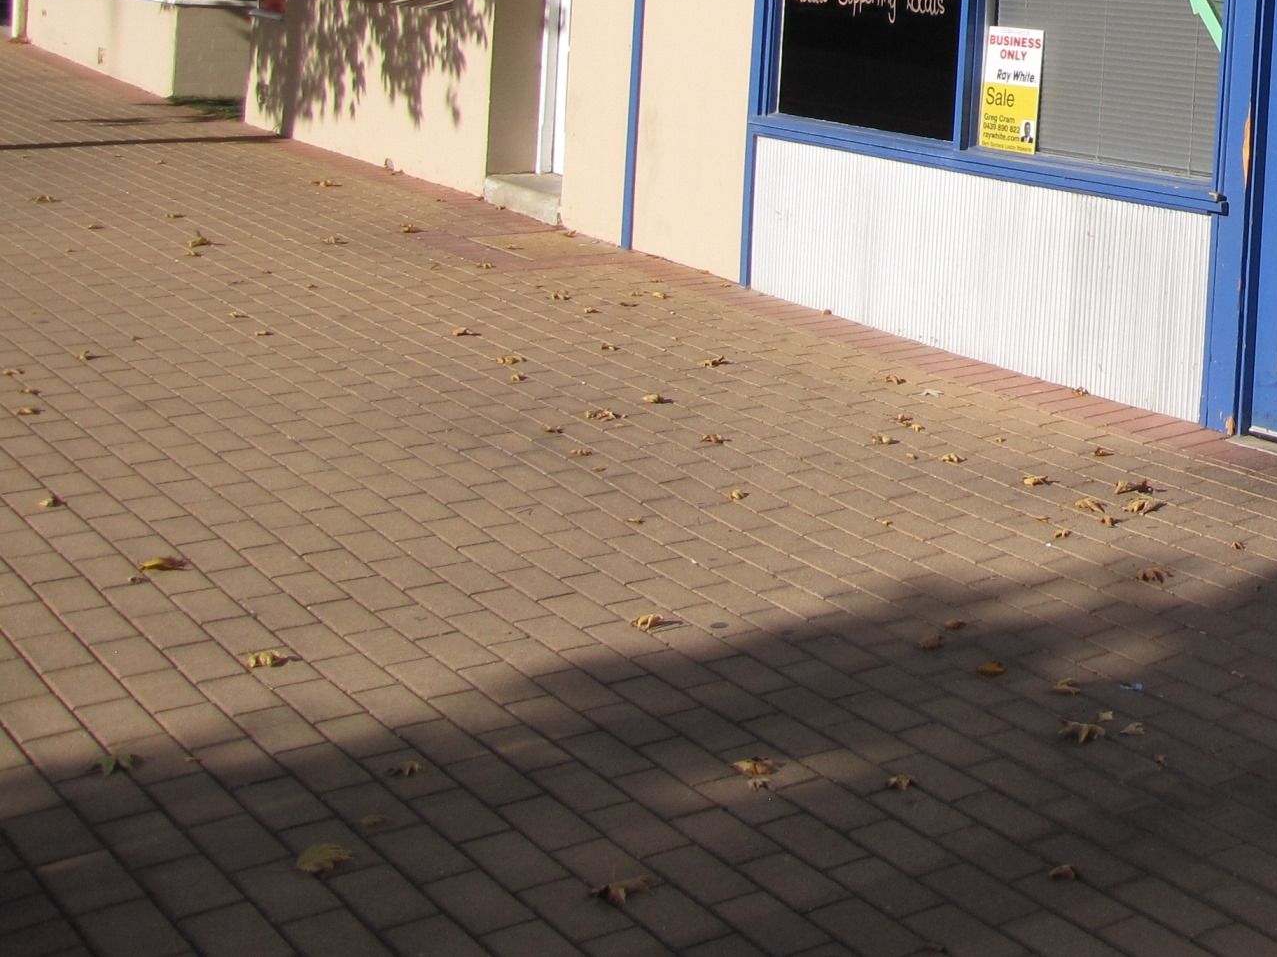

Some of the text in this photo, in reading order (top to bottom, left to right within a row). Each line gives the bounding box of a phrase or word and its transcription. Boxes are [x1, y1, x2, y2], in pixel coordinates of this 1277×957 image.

[989, 34, 1042, 50] BUSINESS
[999, 49, 1028, 61] ONLY
[996, 68, 1012, 83] Ray
[985, 86, 1015, 108] Sale
[983, 112, 998, 123] Greg
[983, 122, 997, 130] 0439
[982, 131, 1020, 142] raywhite.com
